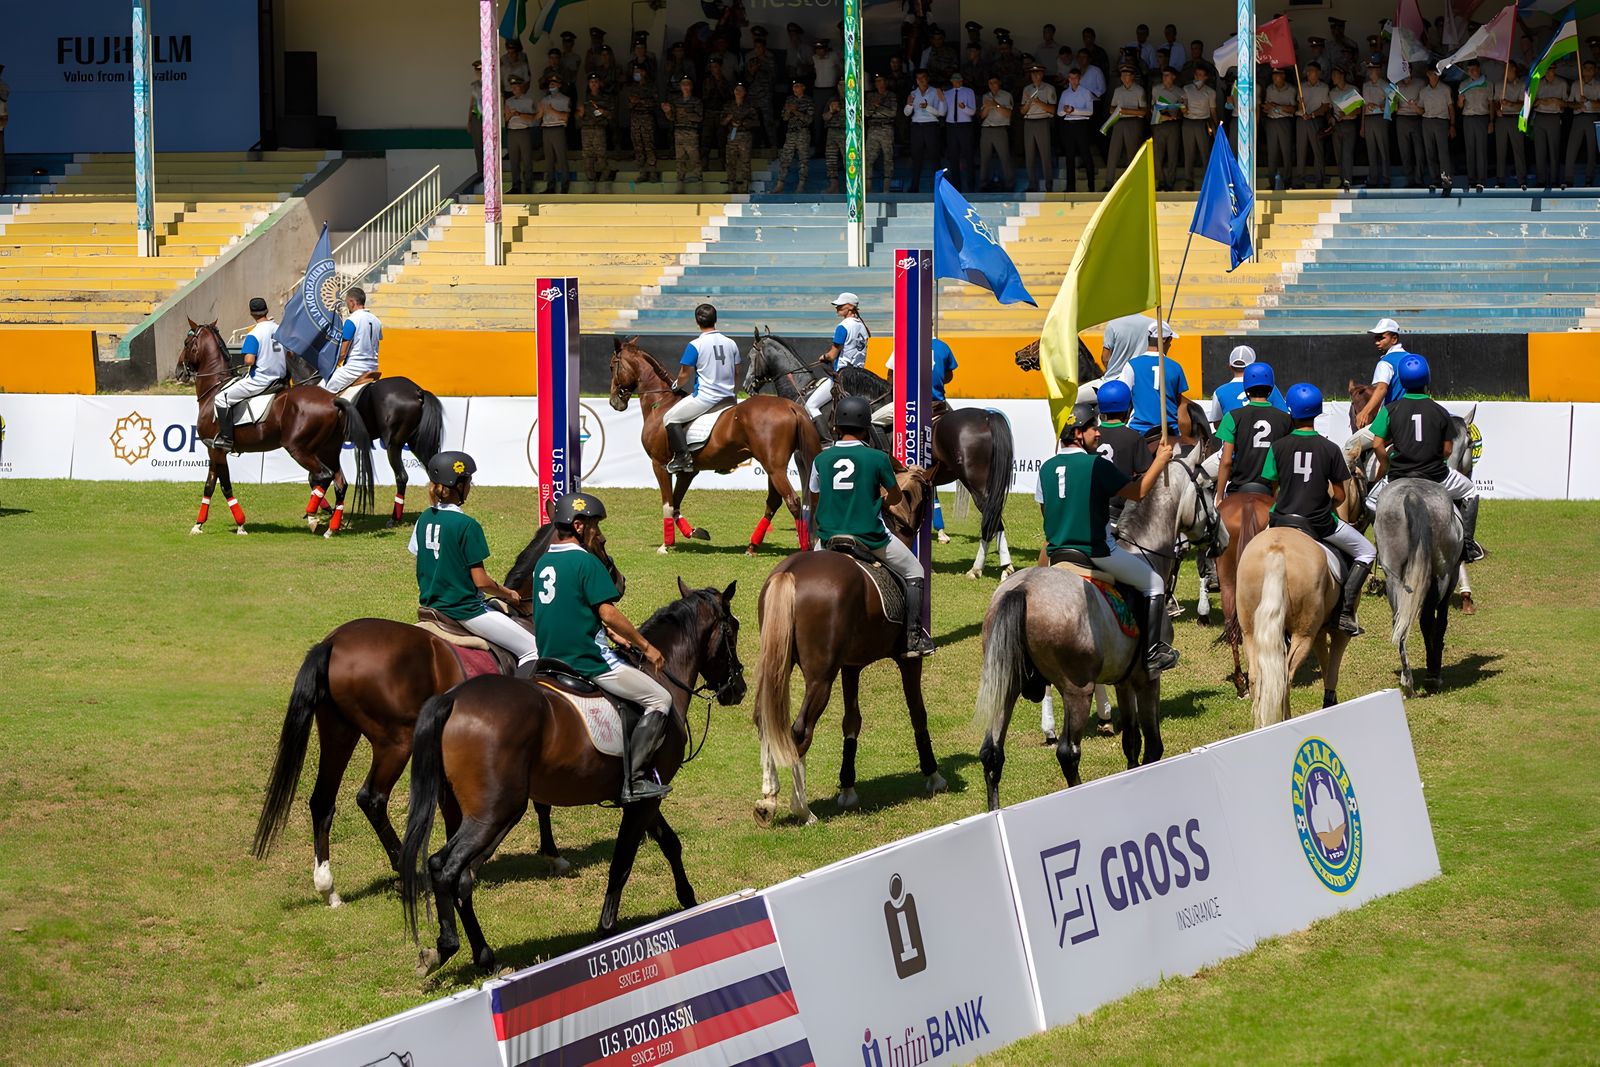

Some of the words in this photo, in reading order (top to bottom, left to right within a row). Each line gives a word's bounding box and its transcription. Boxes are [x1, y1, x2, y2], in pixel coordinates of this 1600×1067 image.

[57, 35, 192, 65] FUJIFLM
[64, 70, 94, 82] Value
[97, 70, 124, 82] from
[128, 70, 188, 82] Ivation
[368, 322, 373, 345] 1
[713, 345, 726, 365] 4
[905, 401, 916, 426] U.S.
[1411, 414, 1422, 442] 1
[924, 425, 932, 469] PUL
[1253, 420, 1272, 448] 2
[551, 447, 564, 476] U.S.
[832, 458, 854, 490] 2
[1294, 452, 1313, 483] 4
[1055, 466, 1066, 499] 1
[425, 523, 441, 560] 4
[538, 566, 556, 604] 3
[1293, 742, 1350, 809] PAXTAKOR
[1100, 818, 1210, 911] GROSS
[1175, 897, 1222, 931] INSURANCE
[587, 956, 612, 979] U.S.
[611, 941, 644, 970] POLO
[645, 929, 680, 959] ASSN.
[600, 1035, 624, 1057] U.S.
[624, 1018, 659, 1049] POLO
[660, 1005, 698, 1036] ASSN.
